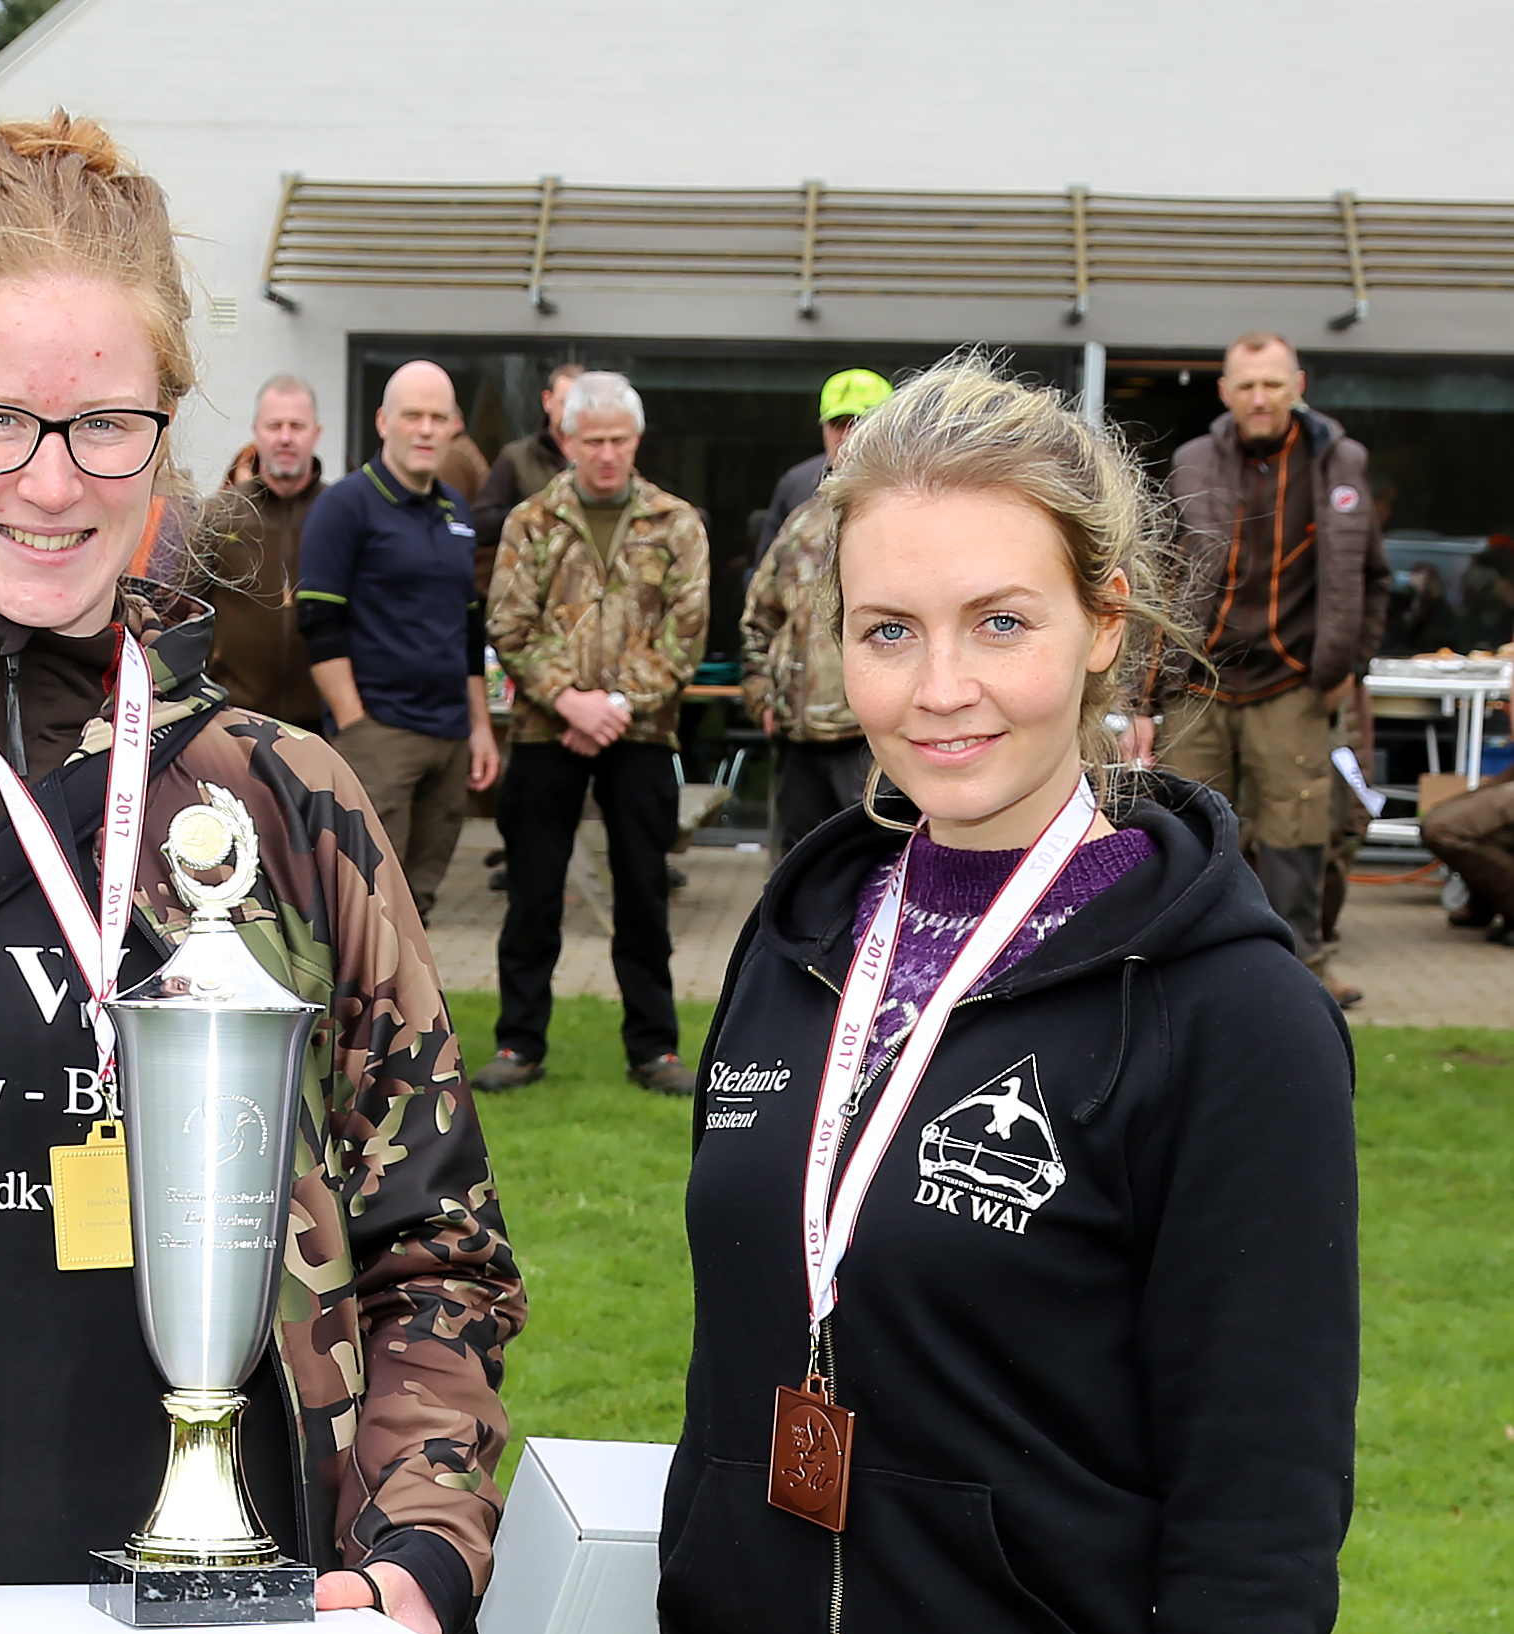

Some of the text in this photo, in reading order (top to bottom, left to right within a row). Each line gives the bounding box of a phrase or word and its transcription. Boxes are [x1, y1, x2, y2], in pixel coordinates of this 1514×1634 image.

[123, 699, 142, 748] 2017
[114, 792, 134, 838] 2017
[107, 882, 124, 927] 2017
[860, 931, 885, 982] 2017
[836, 1022, 860, 1071] 2017
[63, 1066, 124, 1116] B
[706, 1059, 791, 1093] Stefanie
[815, 1118, 836, 1167] 2017
[913, 1179, 1032, 1234] DK WAI
